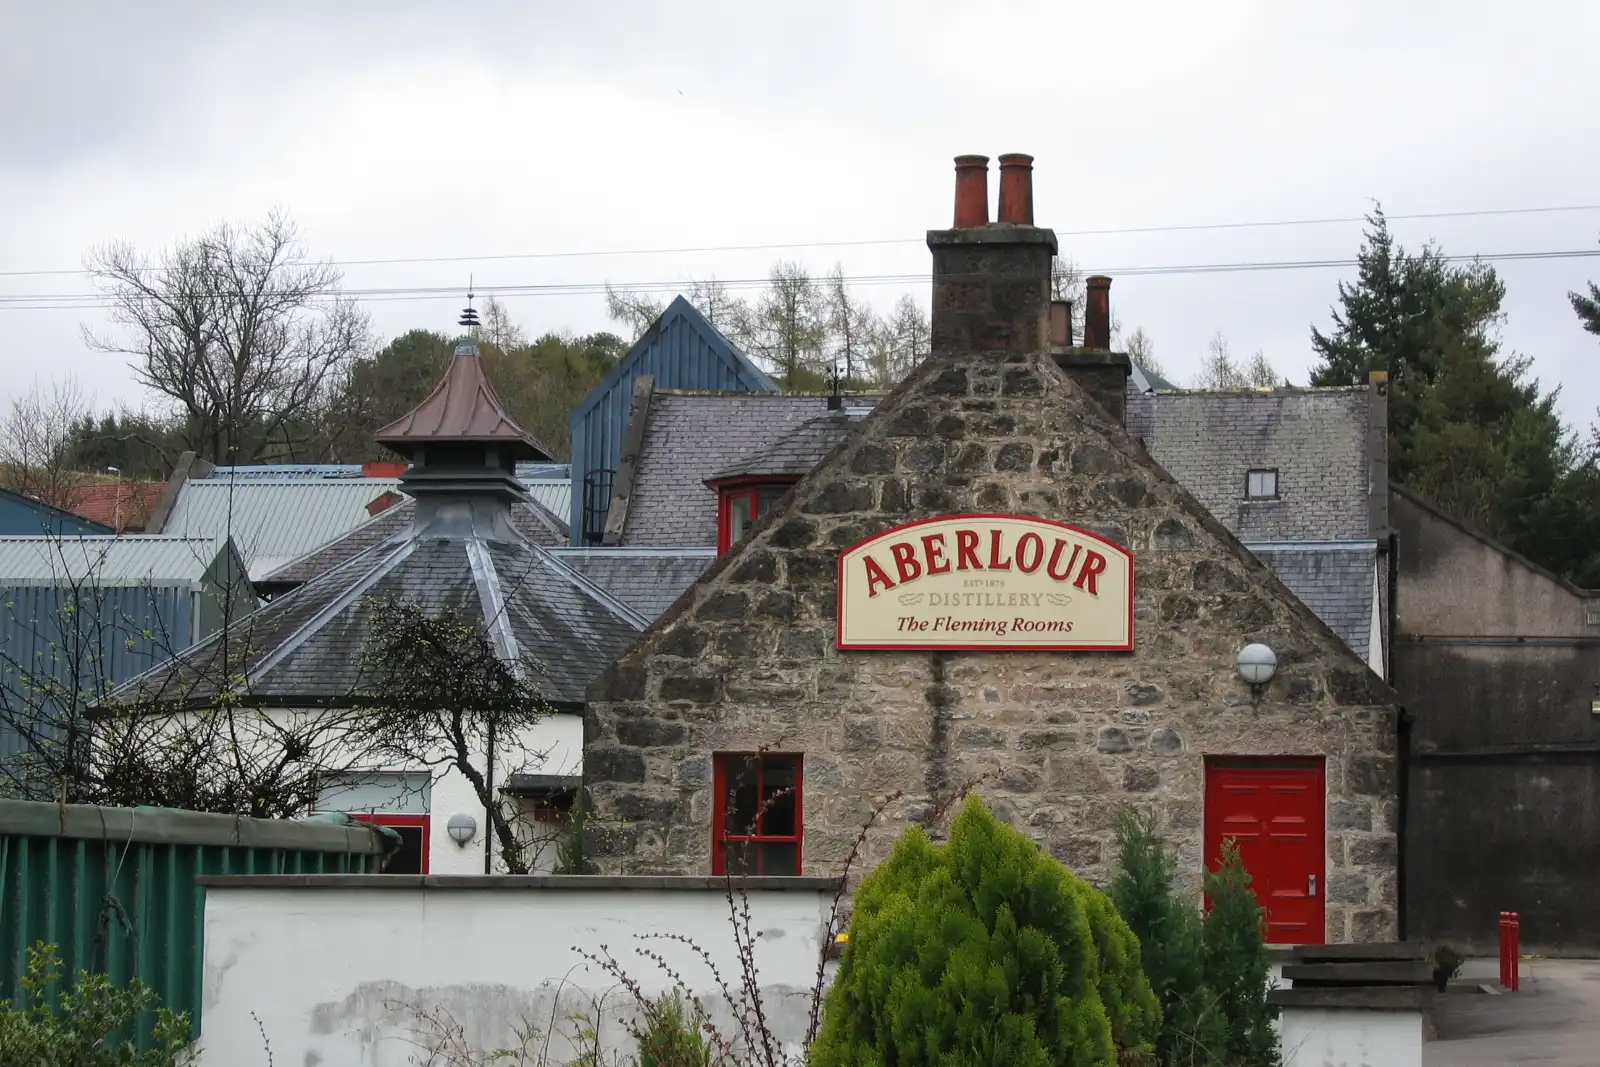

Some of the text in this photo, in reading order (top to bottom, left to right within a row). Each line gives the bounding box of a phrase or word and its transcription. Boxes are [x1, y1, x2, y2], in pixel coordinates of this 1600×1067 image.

[862, 529, 1107, 597] ABERLOUR
[929, 593, 1044, 606] DISTILLERY
[897, 616, 1073, 636] The Fleming Rooms
